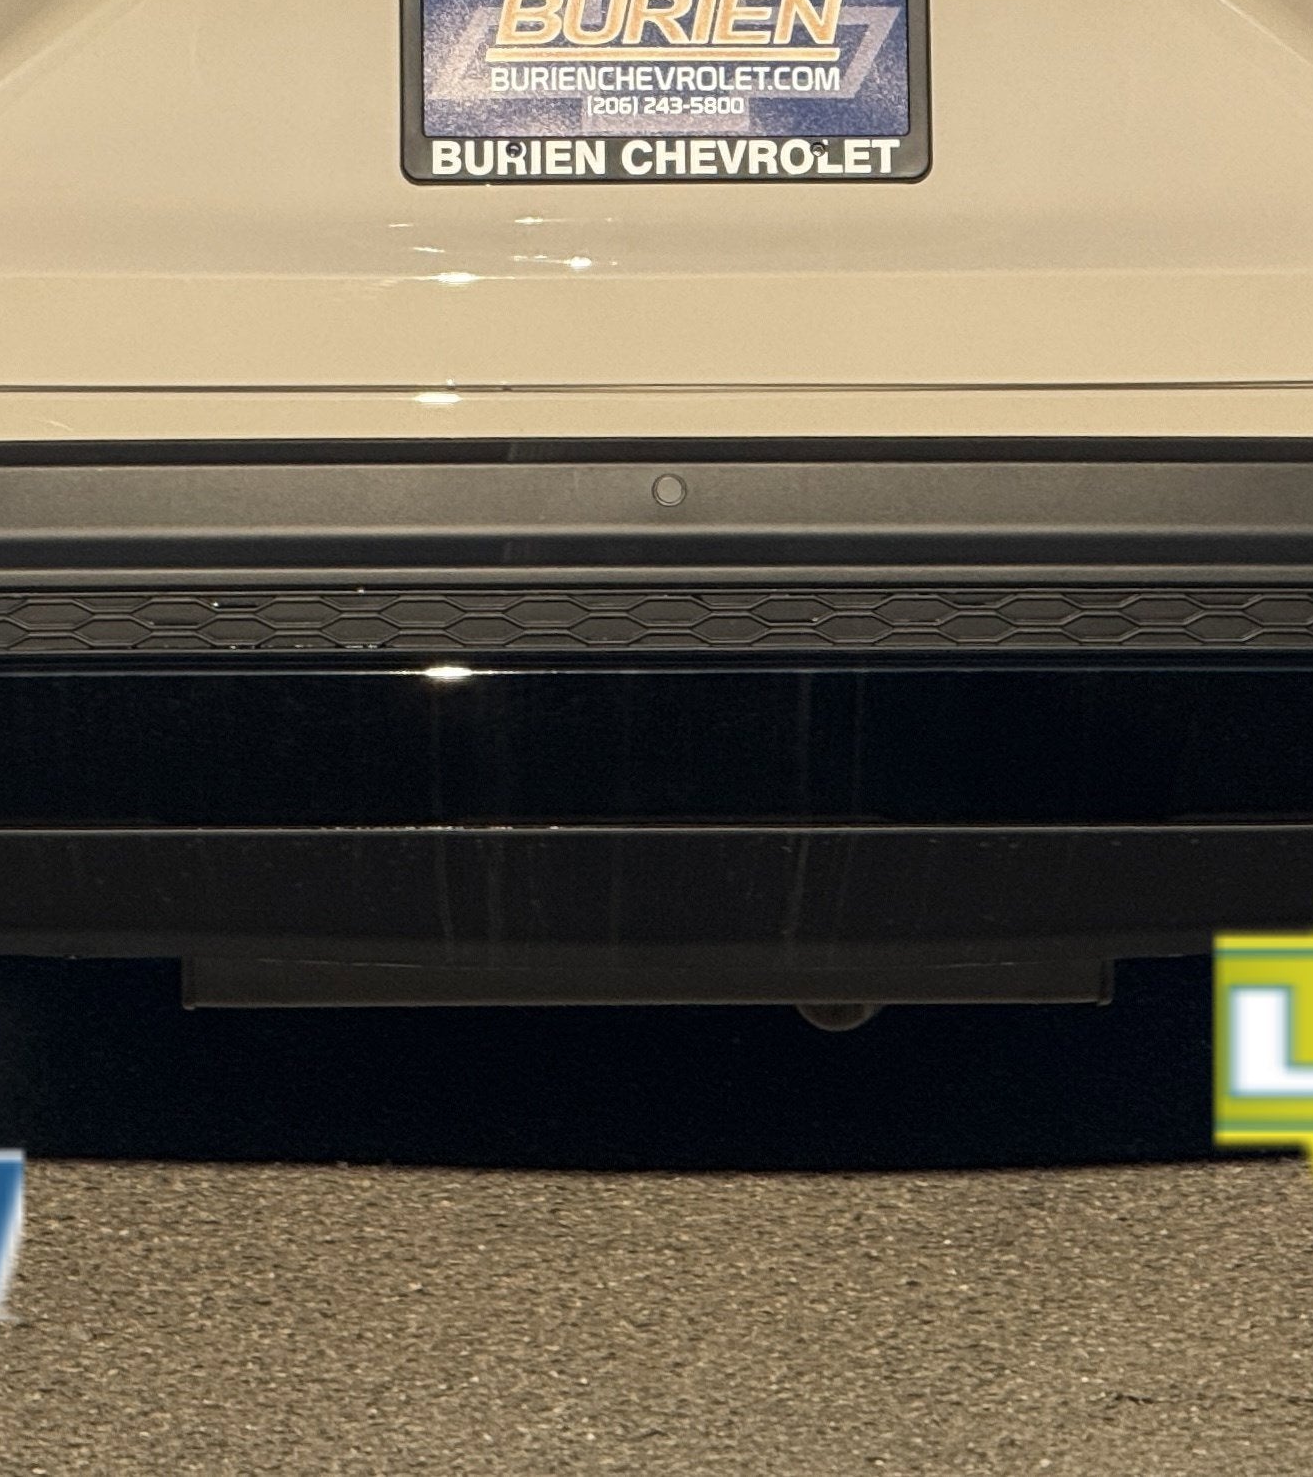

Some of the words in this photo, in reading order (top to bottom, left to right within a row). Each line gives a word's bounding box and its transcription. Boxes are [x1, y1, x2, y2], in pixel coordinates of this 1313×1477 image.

[490, 66, 841, 92] BURIENCHEVROLET.COM
[586, 96, 638, 117] (206)
[643, 96, 745, 116] 243-5800
[432, 139, 614, 176] BURIEN
[622, 138, 900, 176] CHEVROLET
